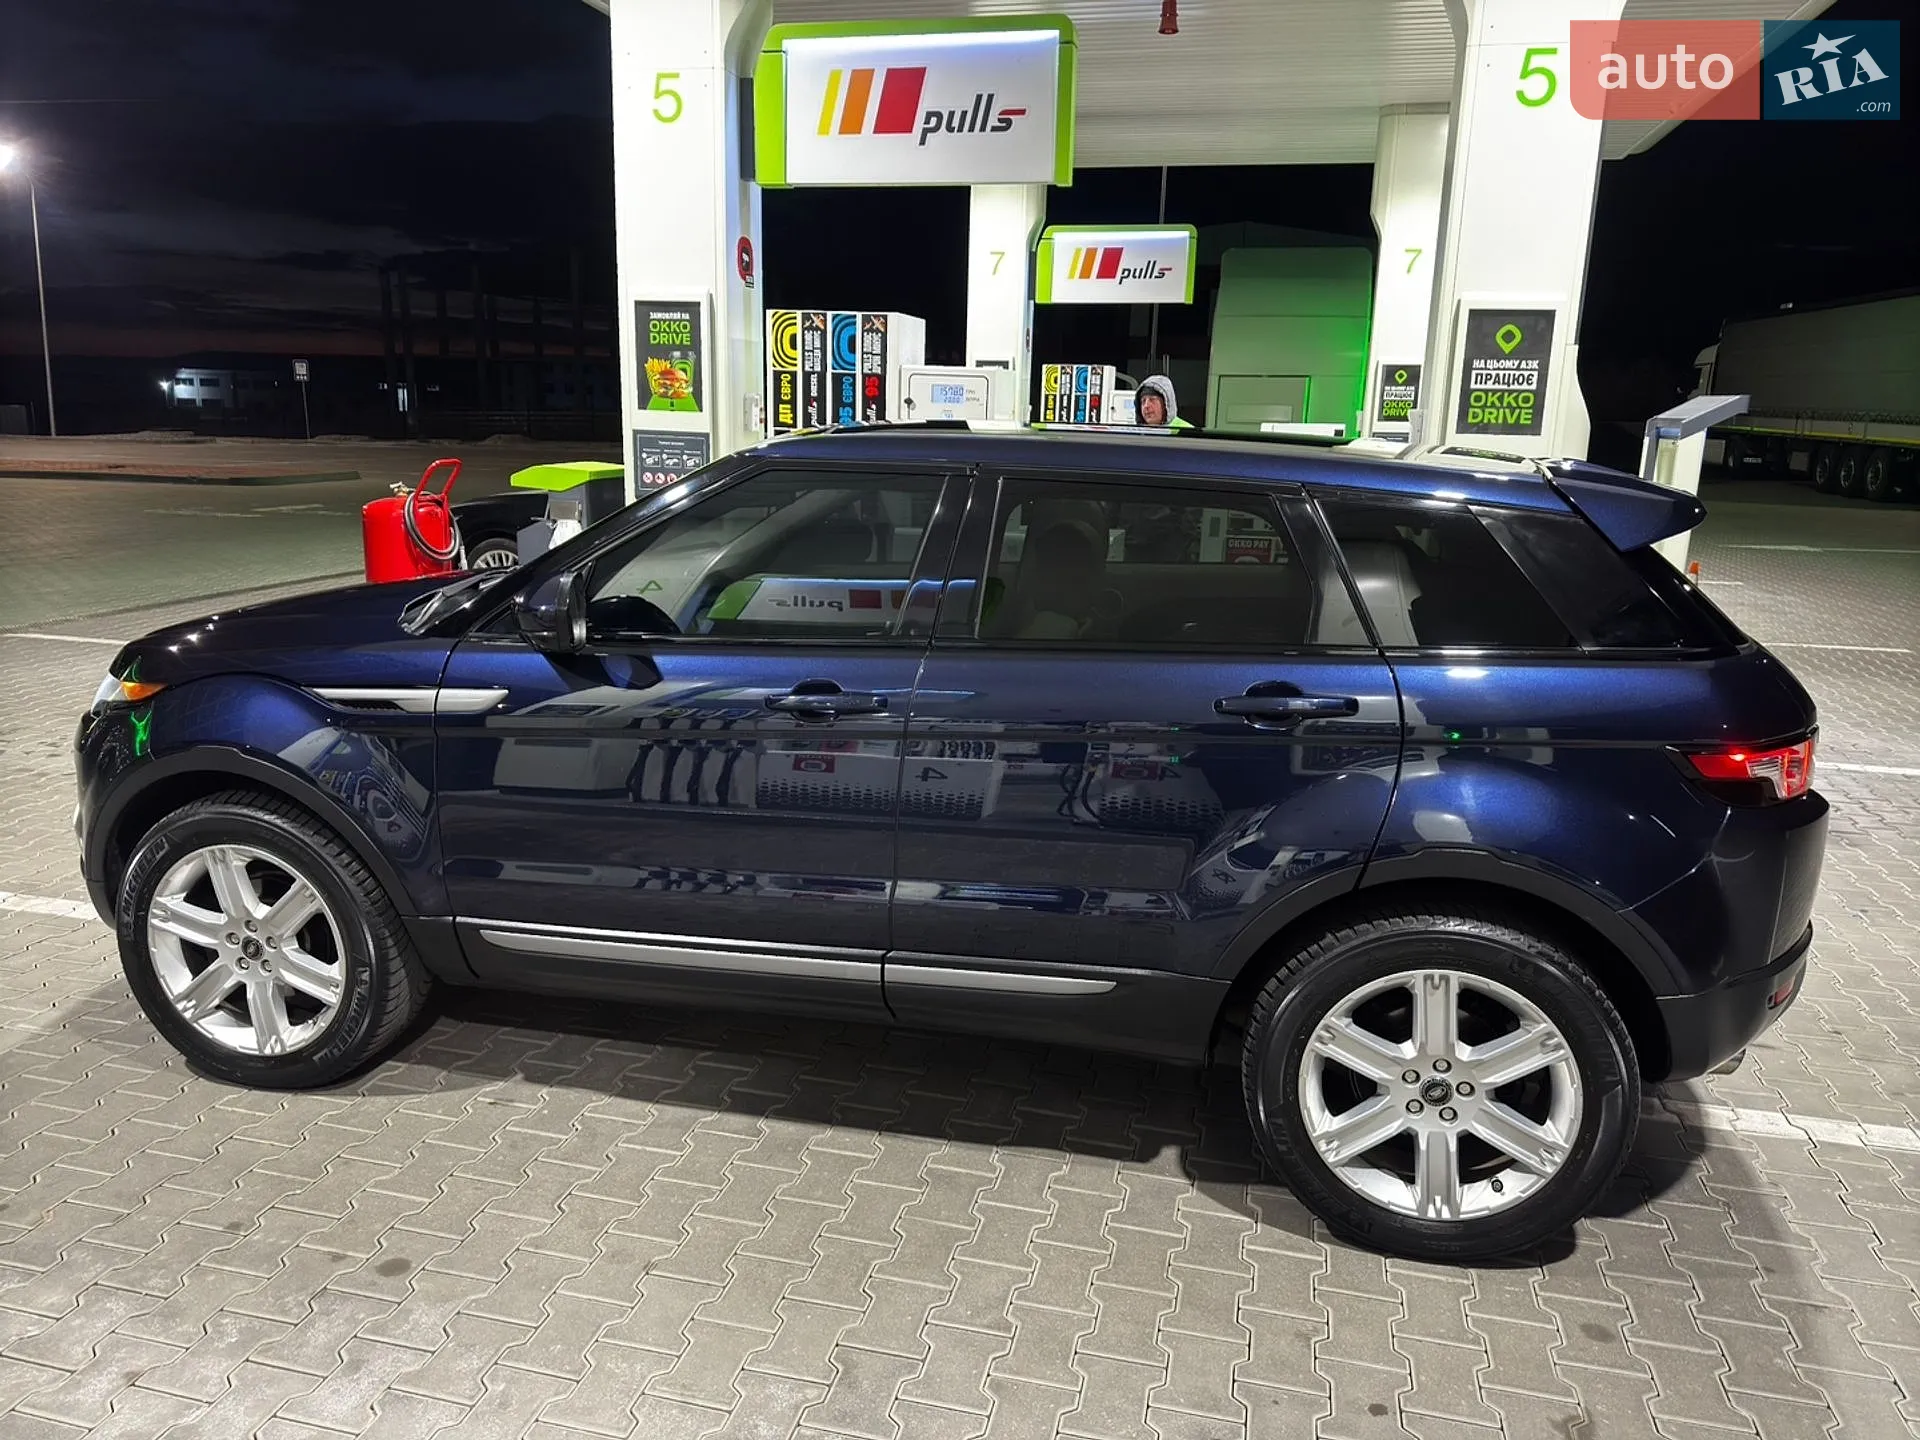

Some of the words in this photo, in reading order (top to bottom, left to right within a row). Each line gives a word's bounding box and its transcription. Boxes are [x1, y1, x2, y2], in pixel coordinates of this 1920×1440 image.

[1515, 48, 1558, 107] 5
[652, 72, 682, 123] 5
[919, 93, 1027, 146] pulls
[990, 251, 1006, 276] 7
[1118, 260, 1173, 285] pulls
[1405, 248, 1422, 274] 7
[649, 320, 690, 333] OKKO
[650, 332, 691, 345] DRIVE
[1472, 359, 1485, 369] НА
[1486, 359, 1520, 370] ЦЬОМУ
[1520, 360, 1539, 369] АЗК
[781, 373, 791, 400] ЄВРО
[842, 375, 853, 403] ЄВРО
[1474, 373, 1535, 388] ПРАЦЮЄ
[1470, 391, 1535, 408] OKKO
[779, 404, 793, 424] ДП
[1467, 408, 1533, 425] DRIVE
